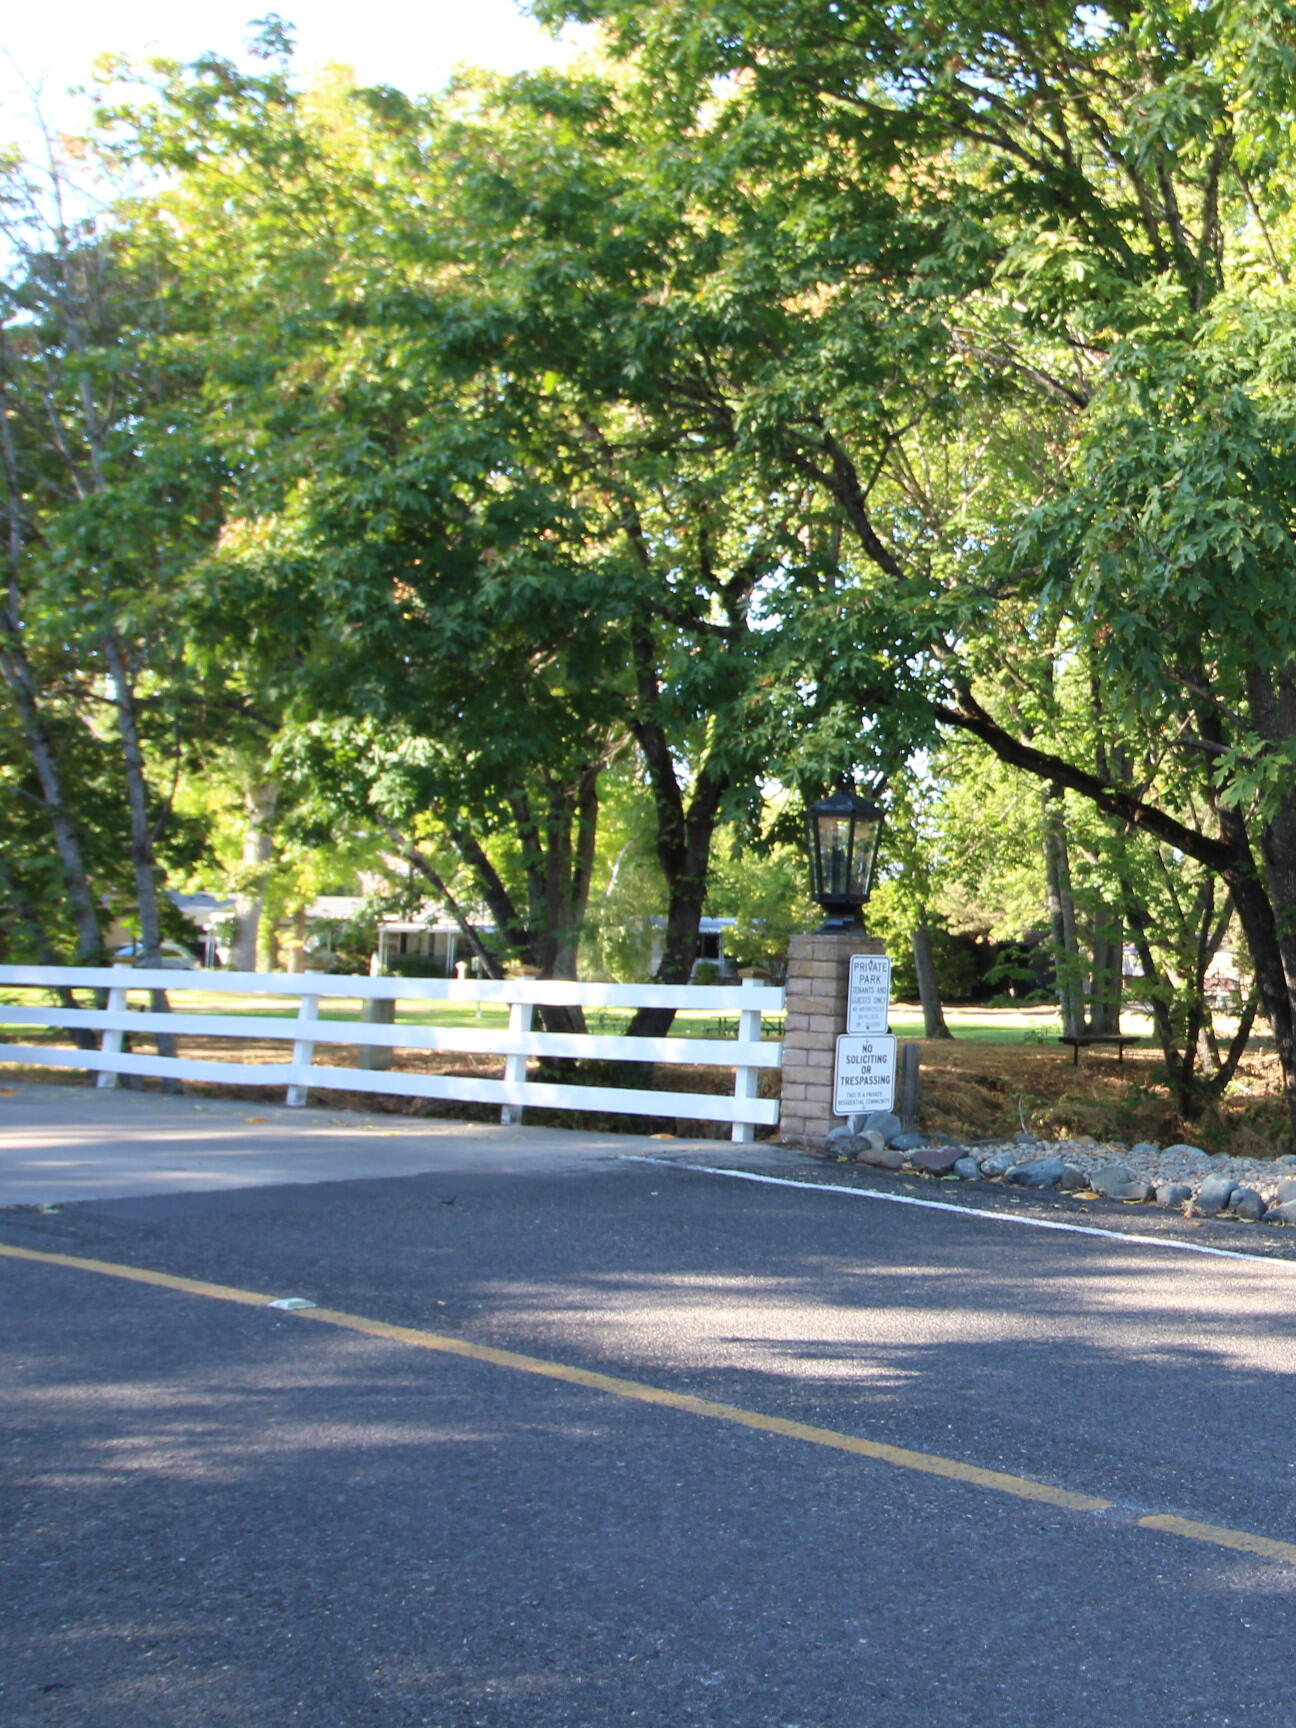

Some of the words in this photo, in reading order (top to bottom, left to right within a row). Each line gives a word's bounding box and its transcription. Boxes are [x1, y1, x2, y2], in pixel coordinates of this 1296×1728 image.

[853, 962, 888, 972] PRIVATE
[859, 975, 881, 984] PARK
[862, 1044, 873, 1053] NO
[846, 1055, 887, 1064] SOLICITING
[861, 1066, 871, 1074] OR
[841, 1076, 890, 1086] TRESPASSING
